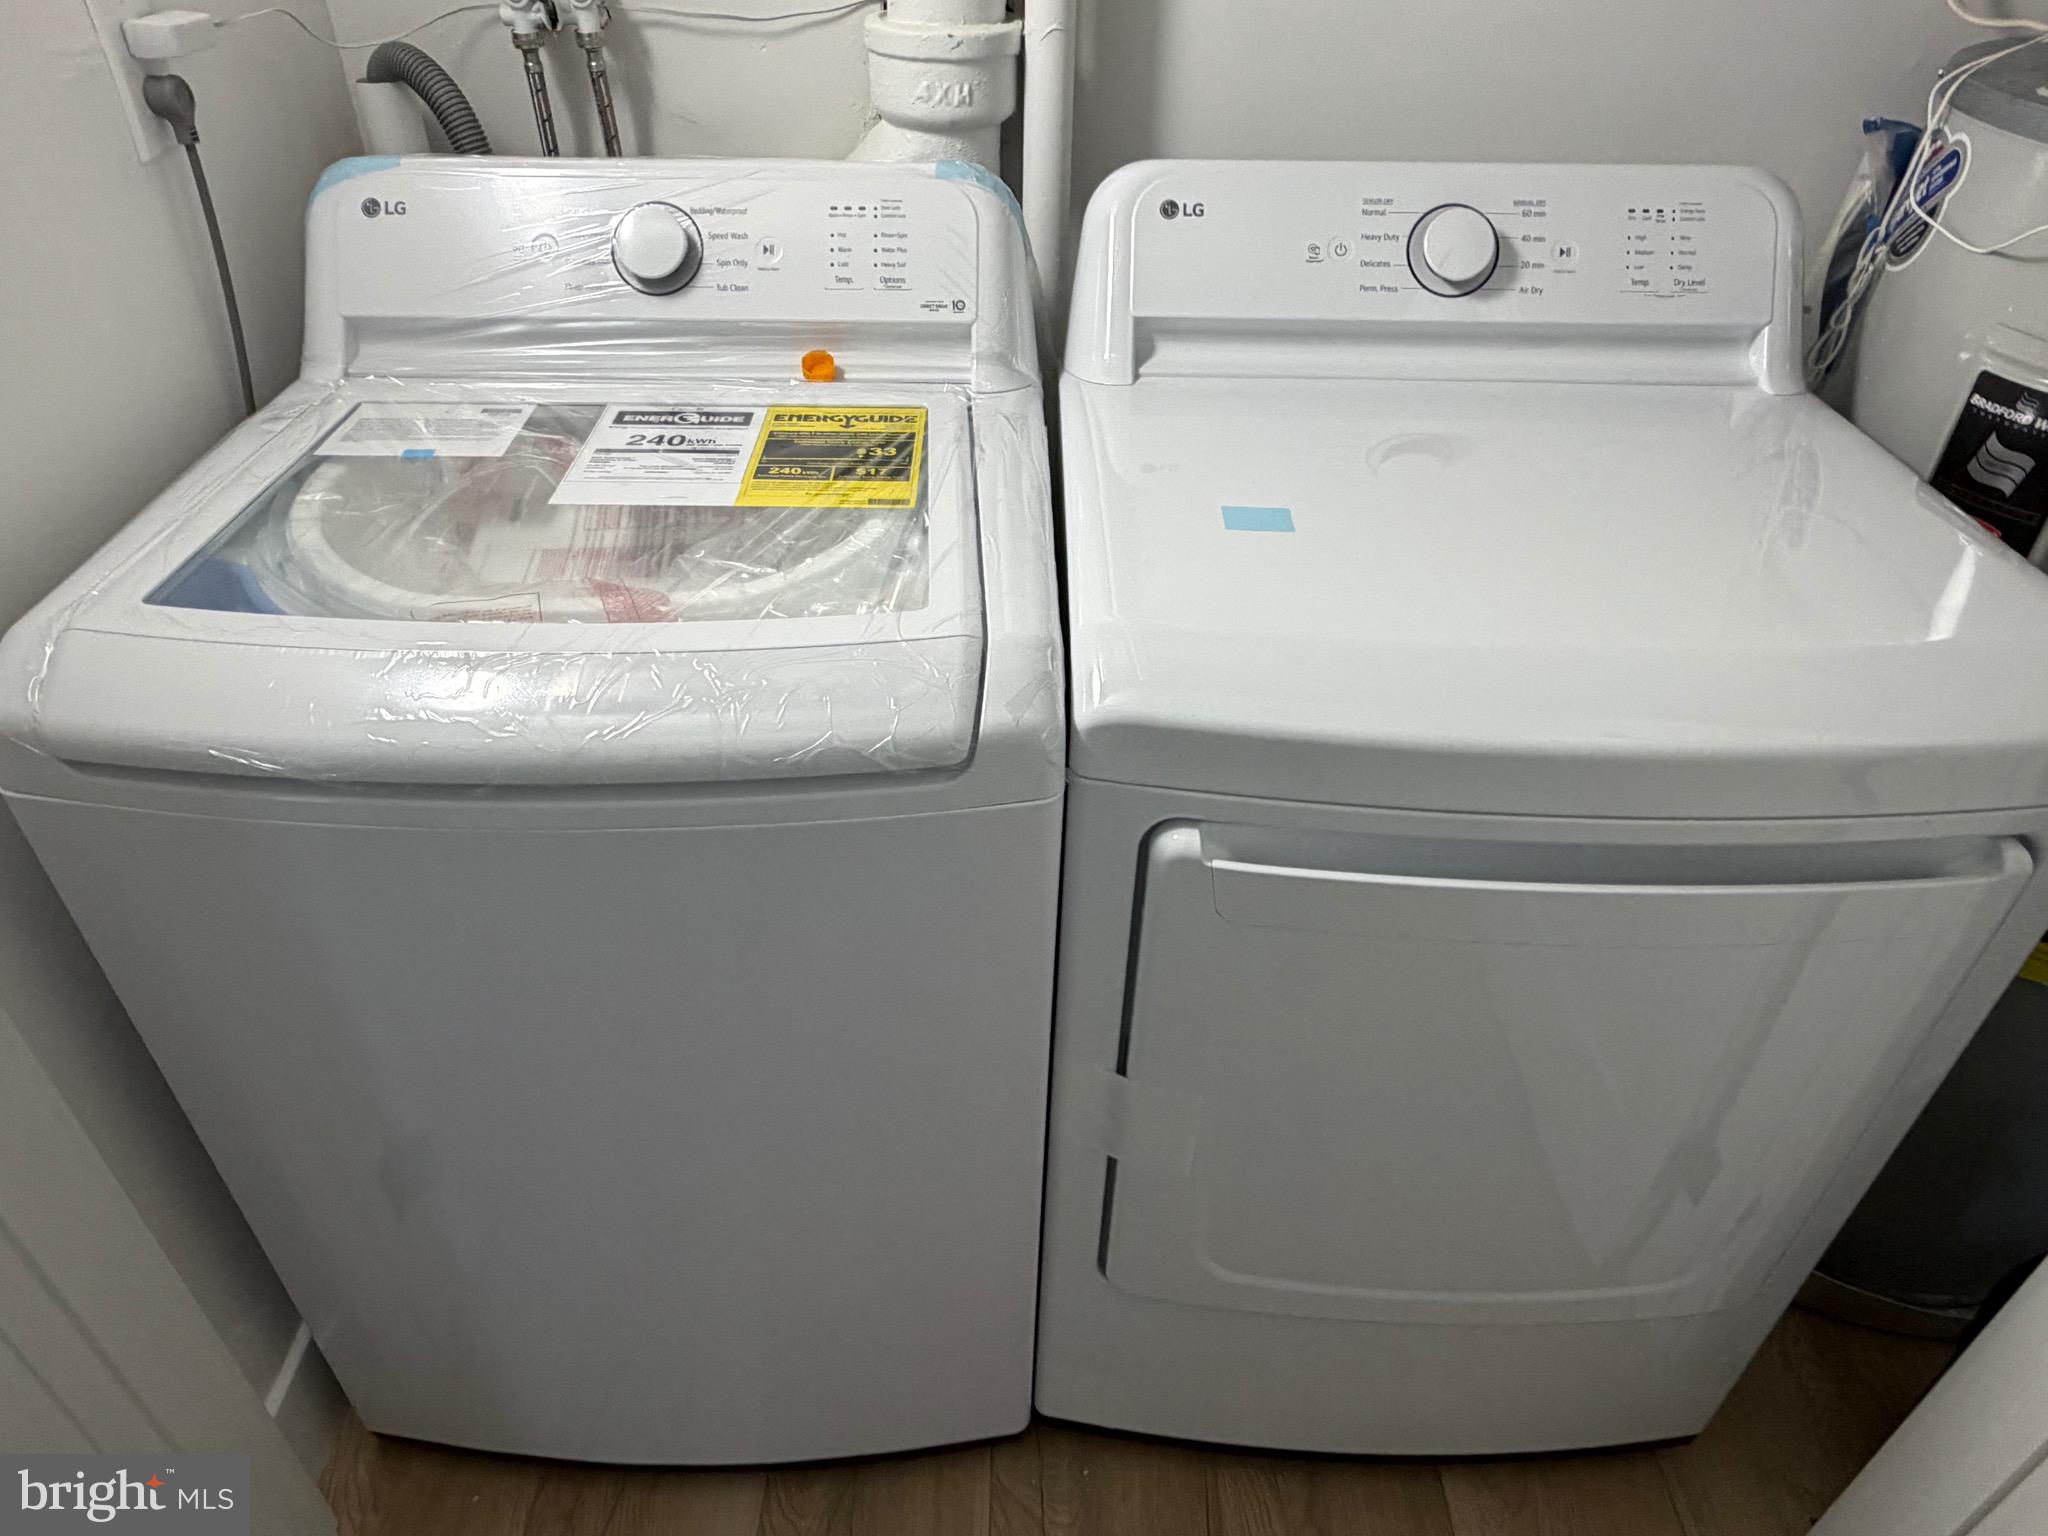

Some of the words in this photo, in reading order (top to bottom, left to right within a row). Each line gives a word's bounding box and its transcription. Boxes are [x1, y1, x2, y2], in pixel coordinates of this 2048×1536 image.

[384, 200, 406, 215] LG
[1182, 202, 1205, 217] LG
[1362, 208, 1387, 216] Normal
[1521, 209, 1533, 217] 60
[708, 231, 729, 243] Speed
[730, 231, 749, 240] Wash
[1361, 233, 1381, 243] Heavy
[1383, 233, 1400, 243] Duty
[1521, 234, 1531, 242] 40
[716, 259, 732, 269] Spin
[732, 258, 748, 269] Only
[1360, 259, 1391, 268] Delicates
[1520, 260, 1530, 269] 20
[835, 275, 854, 285] Temp.
[879, 275, 906, 285] Options
[1673, 278, 1686, 288] Dry
[1687, 278, 1706, 287] Level
[716, 283, 729, 292] Tub
[729, 283, 749, 292] Clean
[1379, 284, 1399, 293] Press
[1519, 286, 1529, 294] Air
[1530, 286, 1543, 296] Dry
[1969, 392, 2035, 426] BRADFORD
[773, 413, 919, 427] ENERGYGUIDE
[625, 434, 687, 447] 240
[686, 437, 716, 445] kWh
[767, 467, 801, 475] 240
